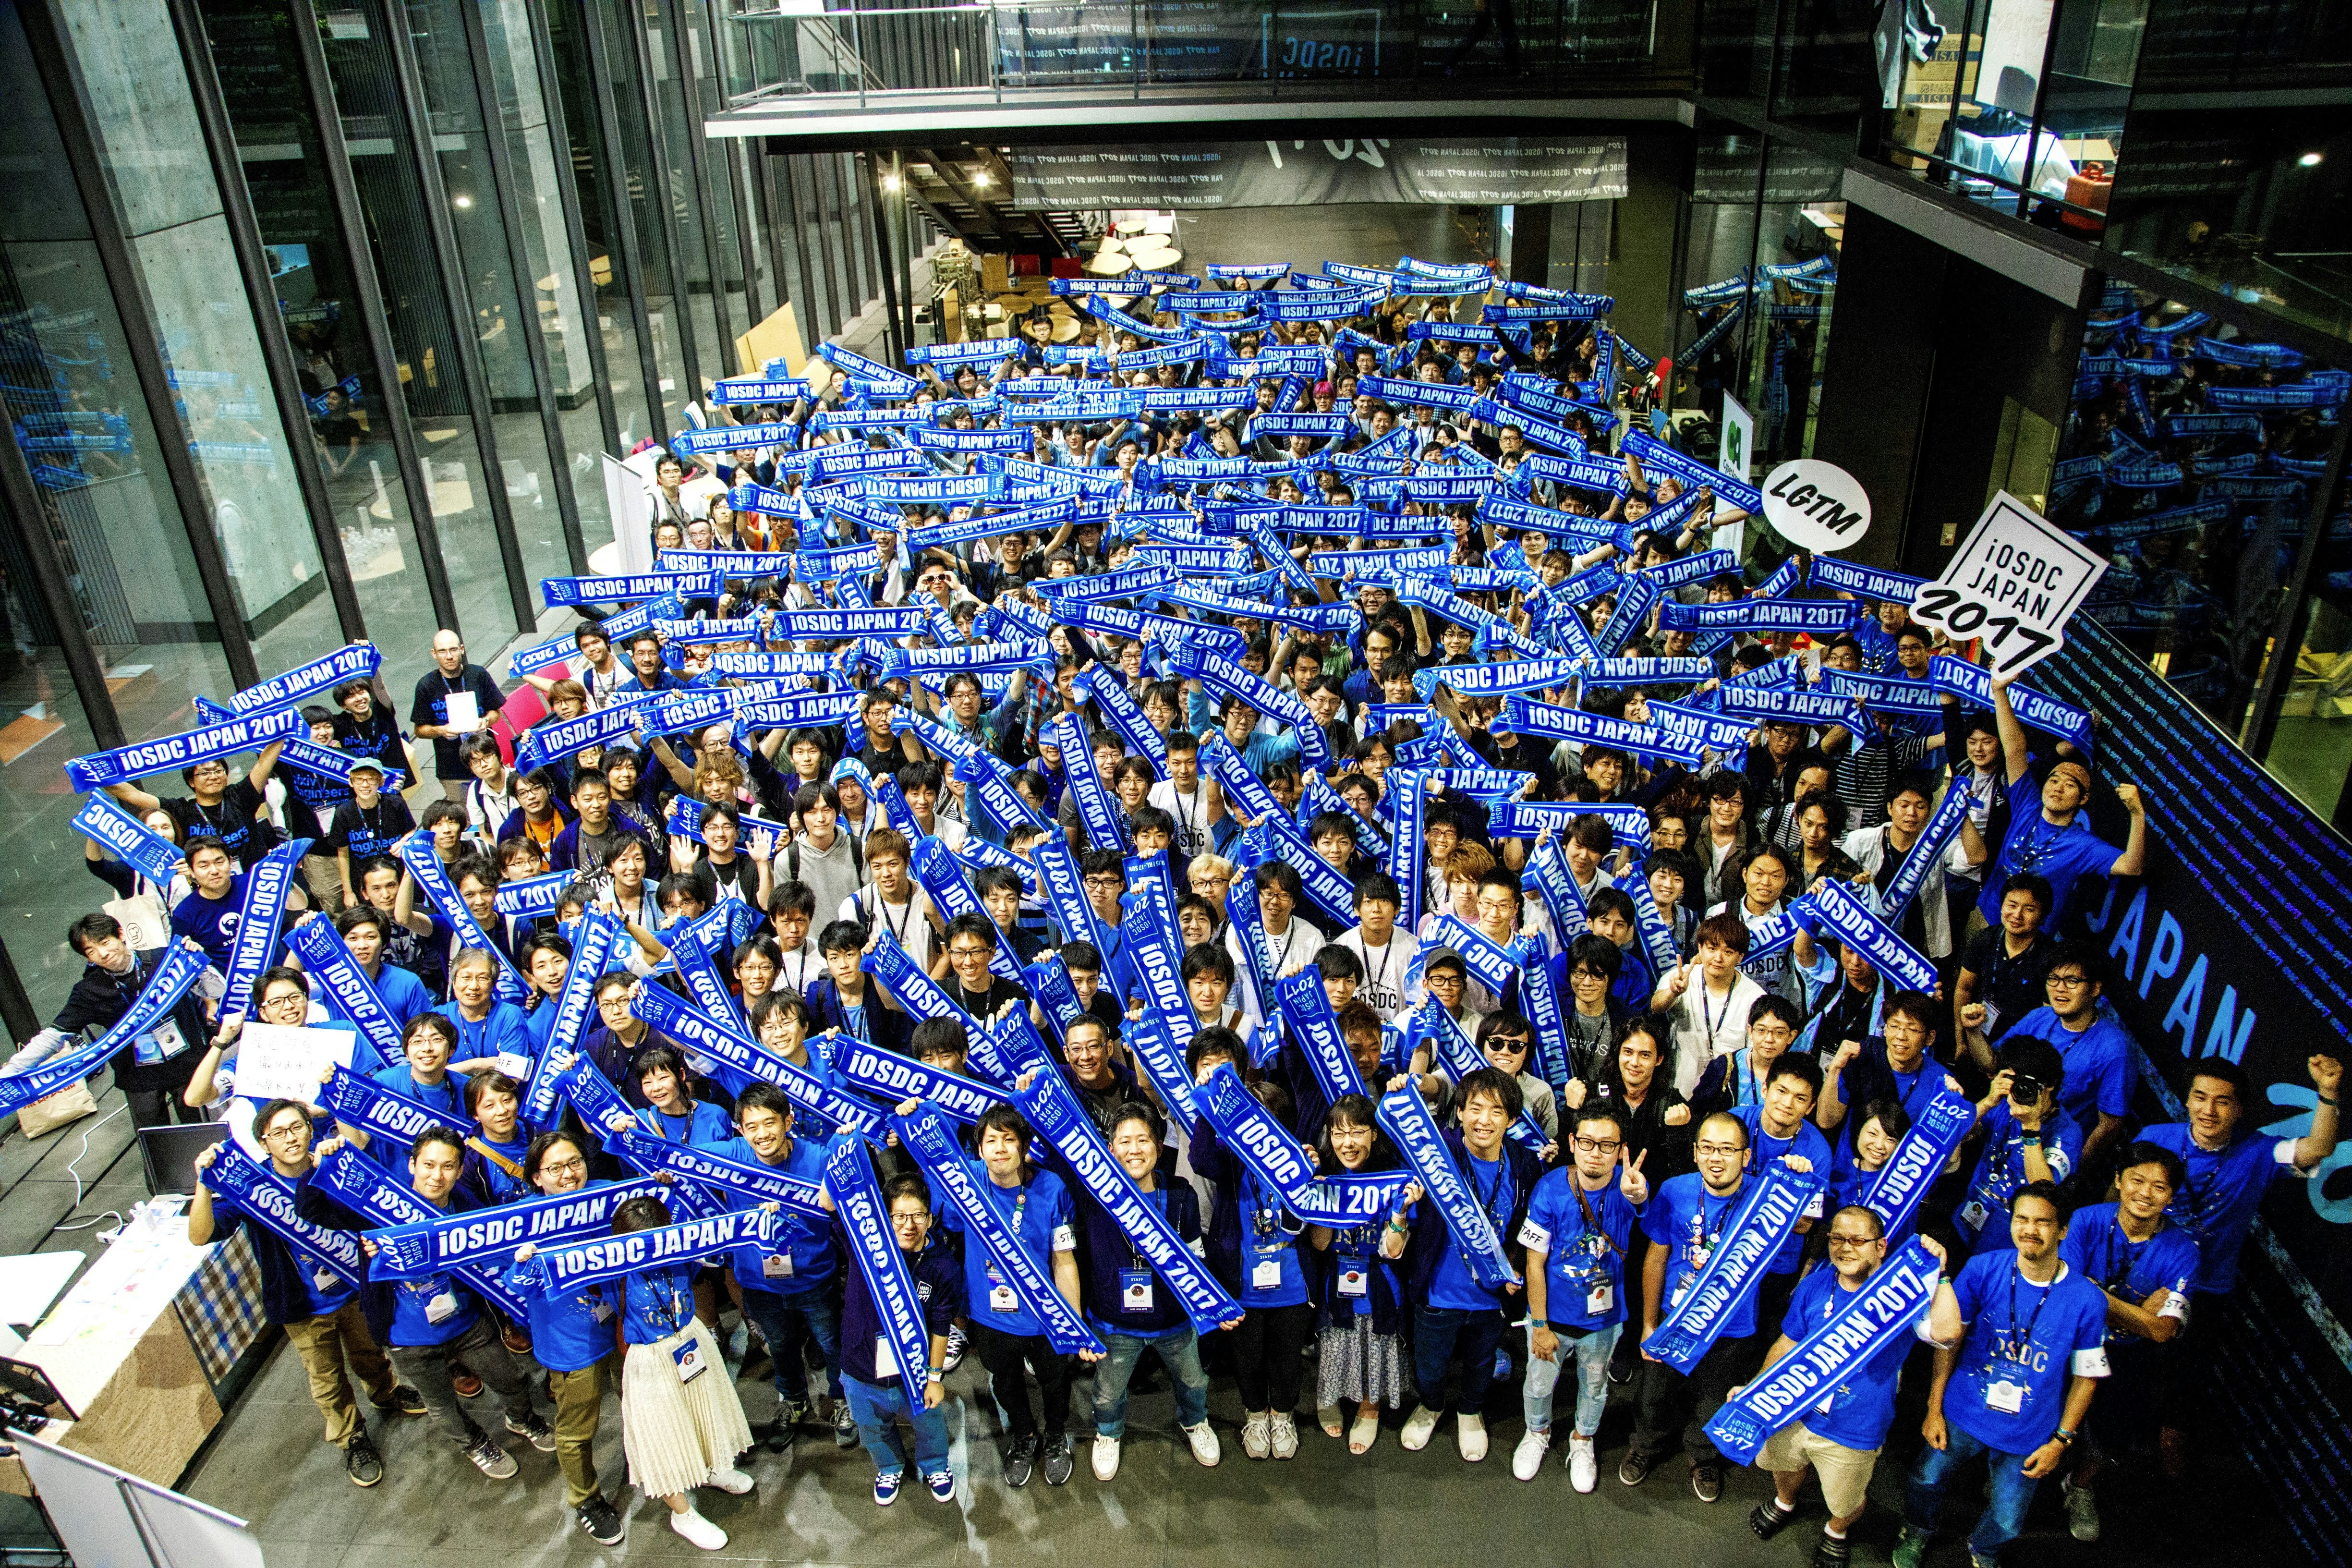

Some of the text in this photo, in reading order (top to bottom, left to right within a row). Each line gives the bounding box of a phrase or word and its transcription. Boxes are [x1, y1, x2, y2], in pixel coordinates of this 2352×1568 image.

[1070, 280, 1145, 292] iOSDC JAPAN 2017
[1219, 264, 1287, 278] iOSDC JAPAN 2017
[1410, 261, 1482, 278] iOSDC JAPAN 2017
[1412, 280, 1489, 292] iOSDC JAPAN 2017
[1171, 296, 1247, 307] iOSDC JAPAN 2017
[1280, 300, 1363, 316] iOSDC JAPAN 2017
[1507, 305, 1594, 316] iOSDC JAPAN 2017
[930, 340, 1018, 357] iOSDC JAPAN 2017
[1432, 325, 1492, 339] iOSDC JAPAN
[1294, 360, 1316, 372] 2017
[726, 383, 798, 399] iOSDC JAPAN
[1149, 391, 1247, 405] iOSDC JAPAN 2017
[1383, 383, 1453, 404] iOSDC JAPAN
[1012, 402, 1119, 418] iOSDC JAPAN 2017
[691, 425, 789, 447] iOSDC JAPAN 2017
[920, 432, 1022, 450] iOSDC JAPAN 2017
[1164, 462, 1202, 474] iOSDC
[1649, 447, 1758, 505] iOSDC JAPAN 2017
[1489, 502, 1616, 539] iOSDC JAPAN 2017
[1770, 473, 1863, 535] LGTM
[664, 554, 753, 571] iOSDC JAPAN
[1986, 539, 2063, 590] iOSDC
[579, 575, 711, 596] iOSDC JAPAN 2017
[1819, 563, 1916, 599] iOSDC JAPAN
[1969, 573, 2051, 620] JAPAN
[1087, 605, 1236, 647] iOSDC 2017
[1700, 605, 1846, 623] iOSDC JAPAN 2017
[1916, 588, 2055, 672] 2017
[715, 654, 825, 672] iOSDC JAPAN
[909, 641, 1016, 666] iOSDC JAPAN
[230, 649, 371, 713] iOSDC JAPAN 2017
[1202, 653, 1324, 757] iOSDC JAPAN 2017
[1724, 687, 1844, 715] iOSDC JAPAN
[2027, 695, 2086, 730] iOSDC
[120, 708, 295, 770] iOSDC JAPAN 2017
[1529, 704, 1703, 754] iOSDC JAPAN 2017
[1059, 724, 1106, 826] iOSDC JAPAN
[1403, 773, 1418, 808] 2017
[85, 804, 144, 857] iOSDC
[522, 884, 561, 910] 2017
[228, 863, 283, 1011] iOSDC JAPAN 2017
[299, 921, 326, 952] 2017
[323, 961, 377, 1018] iOSDC
[557, 924, 612, 1049] JAPAN 2017
[1140, 943, 1181, 1012] iOSDC
[2085, 878, 2256, 1066] JAPAN
[675, 1016, 881, 1133] iOSDC JAPAN 2017
[848, 1050, 928, 1094] iOSDC
[1208, 1075, 1235, 1114] 2017
[826, 1137, 857, 1169] 2017
[1235, 1115, 1298, 1185] iOSDC
[438, 1201, 593, 1255] iOSDC JAPAN
[1058, 1130, 1218, 1310] iOSDC JAPAN 2017
[1517, 1226, 1544, 1245] TAFF
[376, 1236, 404, 1271] 2017
[555, 1219, 737, 1276] iOSDC JAPAN
[1680, 1180, 1802, 1335] iOSDC JAPAN 2017
[847, 1192, 915, 1344] iOSDC JAPAN
[1649, 1345, 1689, 1363] 2017
[1748, 1264, 1924, 1422] iOSDC JAPAN 2017
[1714, 1426, 1754, 1451] 2017
